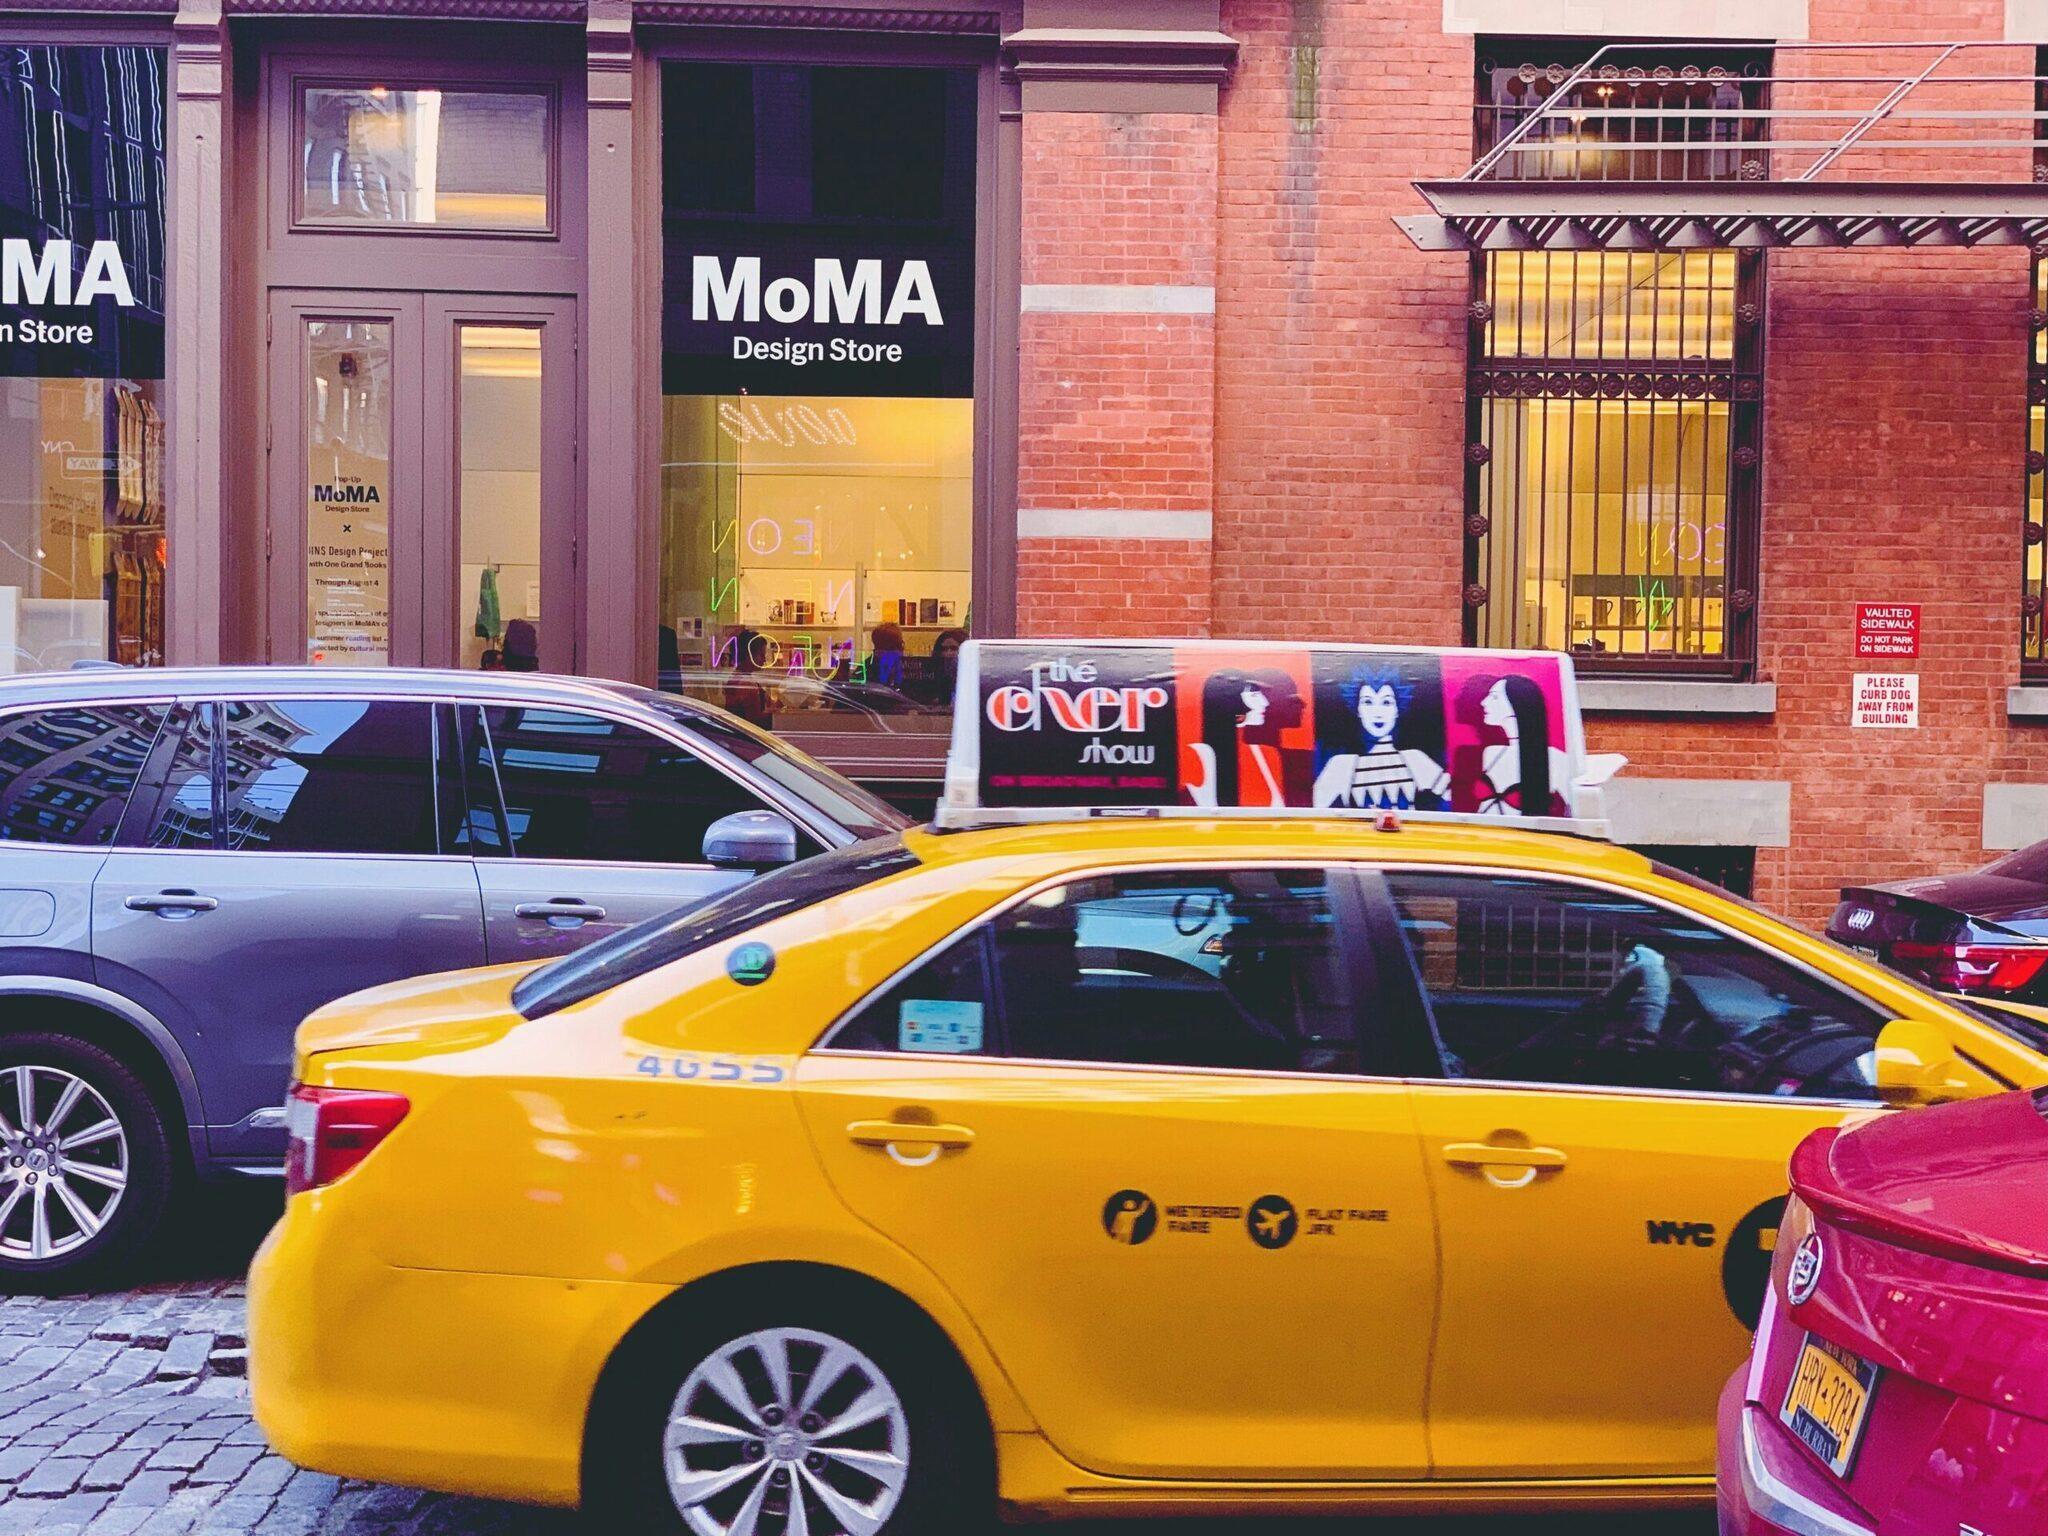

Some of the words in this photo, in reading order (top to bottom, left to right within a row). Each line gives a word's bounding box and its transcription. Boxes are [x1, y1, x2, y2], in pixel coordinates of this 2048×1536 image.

[692, 255, 944, 326] MoMA
[19, 319, 94, 344] Store
[733, 336, 824, 366] Design
[829, 337, 903, 363] Store
[314, 484, 380, 503] MoMA
[325, 505, 350, 513] Design
[308, 546, 326, 555] INS
[328, 546, 356, 558] Design
[315, 579, 346, 587] Through
[1865, 608, 1912, 618] VAULTED
[1861, 619, 1915, 629] SIDEWALK
[1861, 636, 1873, 644] DO
[1874, 636, 1890, 644] NOT
[1892, 637, 1913, 645] PARK
[1860, 645, 1872, 653] ON
[1874, 645, 1914, 653] SIDEWALK
[1049, 657, 1098, 683] the
[1867, 678, 1905, 688] PLEASE
[986, 666, 1169, 733] cher
[1861, 690, 1887, 700] CURB
[1891, 690, 1911, 700] DOG
[1858, 702, 1882, 711] AWAY
[1887, 702, 1914, 712] FROM
[1862, 714, 1908, 724] BUILDING
[1078, 737, 1155, 765] show
[1348, 1209, 1389, 1222] FARE
[1167, 1220, 1211, 1234] FARE
[1646, 1219, 1716, 1248] NYC
